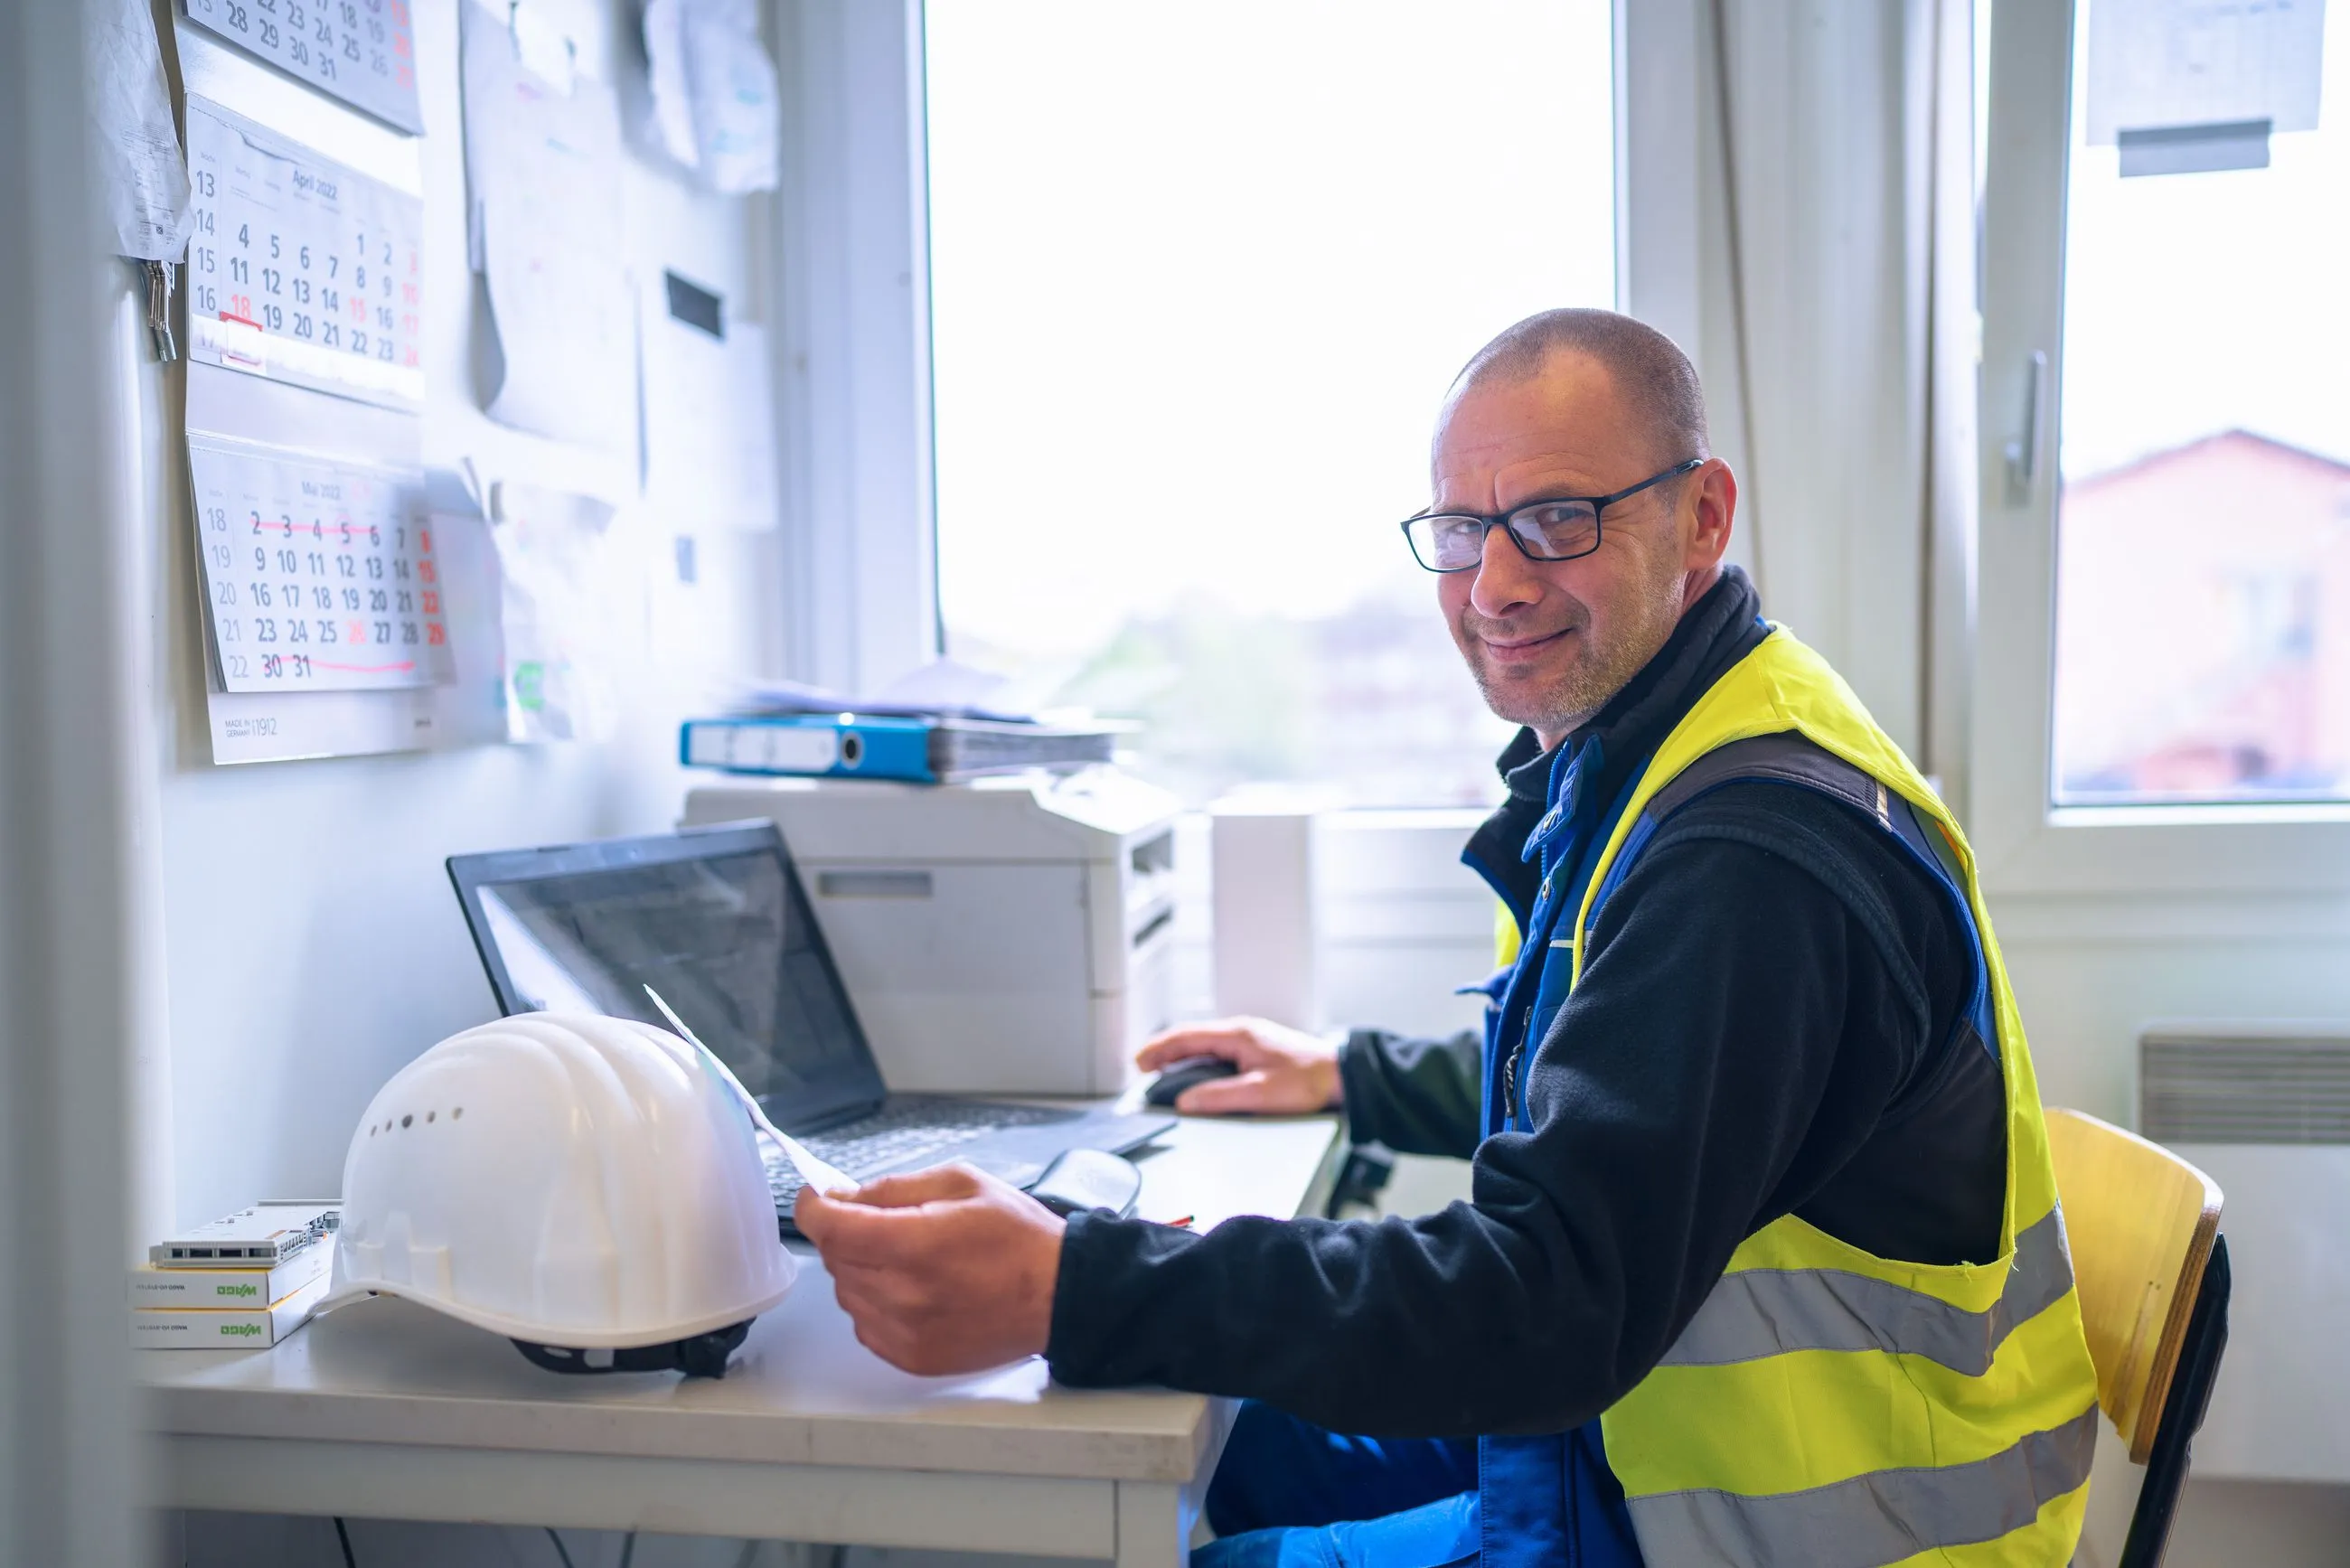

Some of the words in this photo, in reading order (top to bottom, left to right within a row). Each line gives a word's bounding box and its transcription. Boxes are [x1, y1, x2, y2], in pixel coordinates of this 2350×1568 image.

[287, 0, 305, 30] 23
[315, 16, 334, 48] 24
[342, 33, 361, 63] 25
[340, 0, 357, 30] 18
[226, 0, 249, 33] 28
[258, 18, 279, 49] 29
[289, 35, 308, 66] 30
[318, 51, 336, 81] 31
[293, 169, 315, 190] April
[316, 176, 338, 201] 2022
[196, 170, 215, 198] 13
[357, 233, 363, 256] 1
[384, 242, 392, 267] 2
[196, 208, 215, 236] 14
[239, 223, 249, 249] 4
[271, 234, 280, 259] 5
[300, 246, 310, 269] 6
[329, 255, 338, 278] 7
[357, 266, 365, 288] 8
[197, 247, 215, 273] 15
[230, 257, 249, 285] 11
[262, 268, 281, 296] 12
[293, 277, 310, 304] 13
[322, 286, 339, 312] 14
[376, 306, 393, 330] 16
[197, 285, 216, 311] 16
[230, 294, 251, 319] 18
[262, 304, 282, 330] 19
[294, 312, 313, 339] 20
[323, 320, 340, 347] 21
[352, 329, 368, 355] 22
[378, 337, 394, 361] 23
[301, 481, 318, 497] Mai
[207, 507, 227, 531] 18
[251, 510, 262, 535] 2
[281, 514, 293, 538] 3
[313, 518, 323, 542] 4
[341, 521, 351, 544] 5
[370, 524, 381, 548] 6
[396, 526, 405, 549] 7
[212, 545, 231, 568] 19
[255, 546, 266, 571] 9
[277, 549, 296, 574] 10
[307, 551, 325, 577] 11
[335, 554, 356, 577] 12
[366, 556, 383, 580] 13
[393, 557, 409, 580] 14
[217, 580, 237, 606] 20
[250, 582, 271, 607] 16
[281, 584, 300, 608] 17
[312, 586, 332, 610] 18
[342, 587, 361, 611] 19
[369, 588, 389, 613] 20
[396, 589, 413, 614] 21
[222, 618, 241, 643] 21
[255, 617, 277, 643] 23
[287, 618, 309, 643] 24
[316, 619, 338, 643] 25
[373, 620, 390, 644] 27
[229, 654, 249, 679] 22
[261, 653, 283, 679] 30
[292, 653, 312, 679] 31
[217, 1283, 257, 1298] WAGO
[220, 1322, 261, 1338] WAGO
